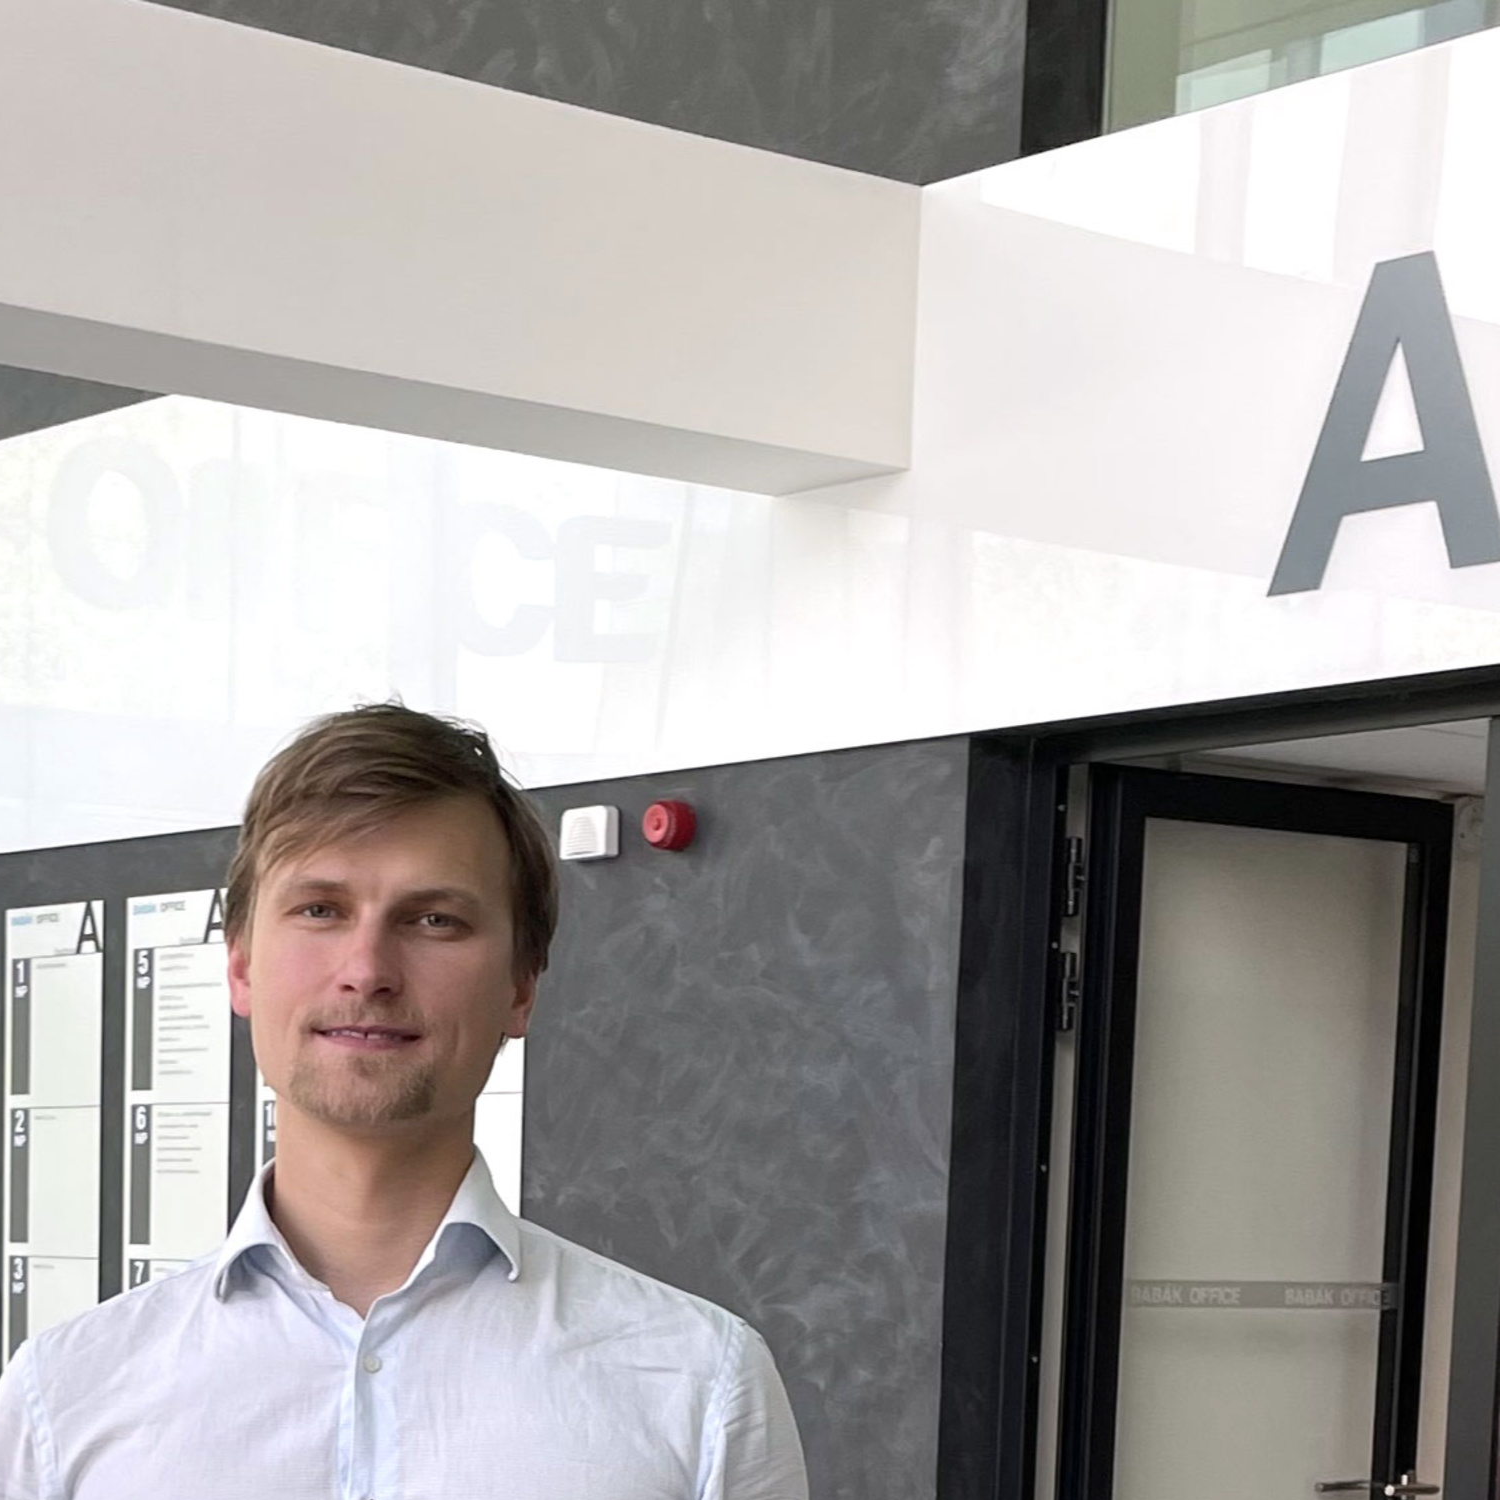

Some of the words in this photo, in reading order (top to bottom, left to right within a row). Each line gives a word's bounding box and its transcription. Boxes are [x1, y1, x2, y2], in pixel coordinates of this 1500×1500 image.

[1266, 250, 1500, 598] A
[76, 901, 102, 954] A
[203, 889, 225, 943] A
[16, 960, 25, 983] 1
[138, 950, 149, 975] 5
[15, 1110, 25, 1132] 2
[136, 1106, 147, 1130] 6
[13, 1257, 23, 1280] 3
[133, 1261, 145, 1284] 7
[1189, 1287, 1241, 1305] OFFICE
